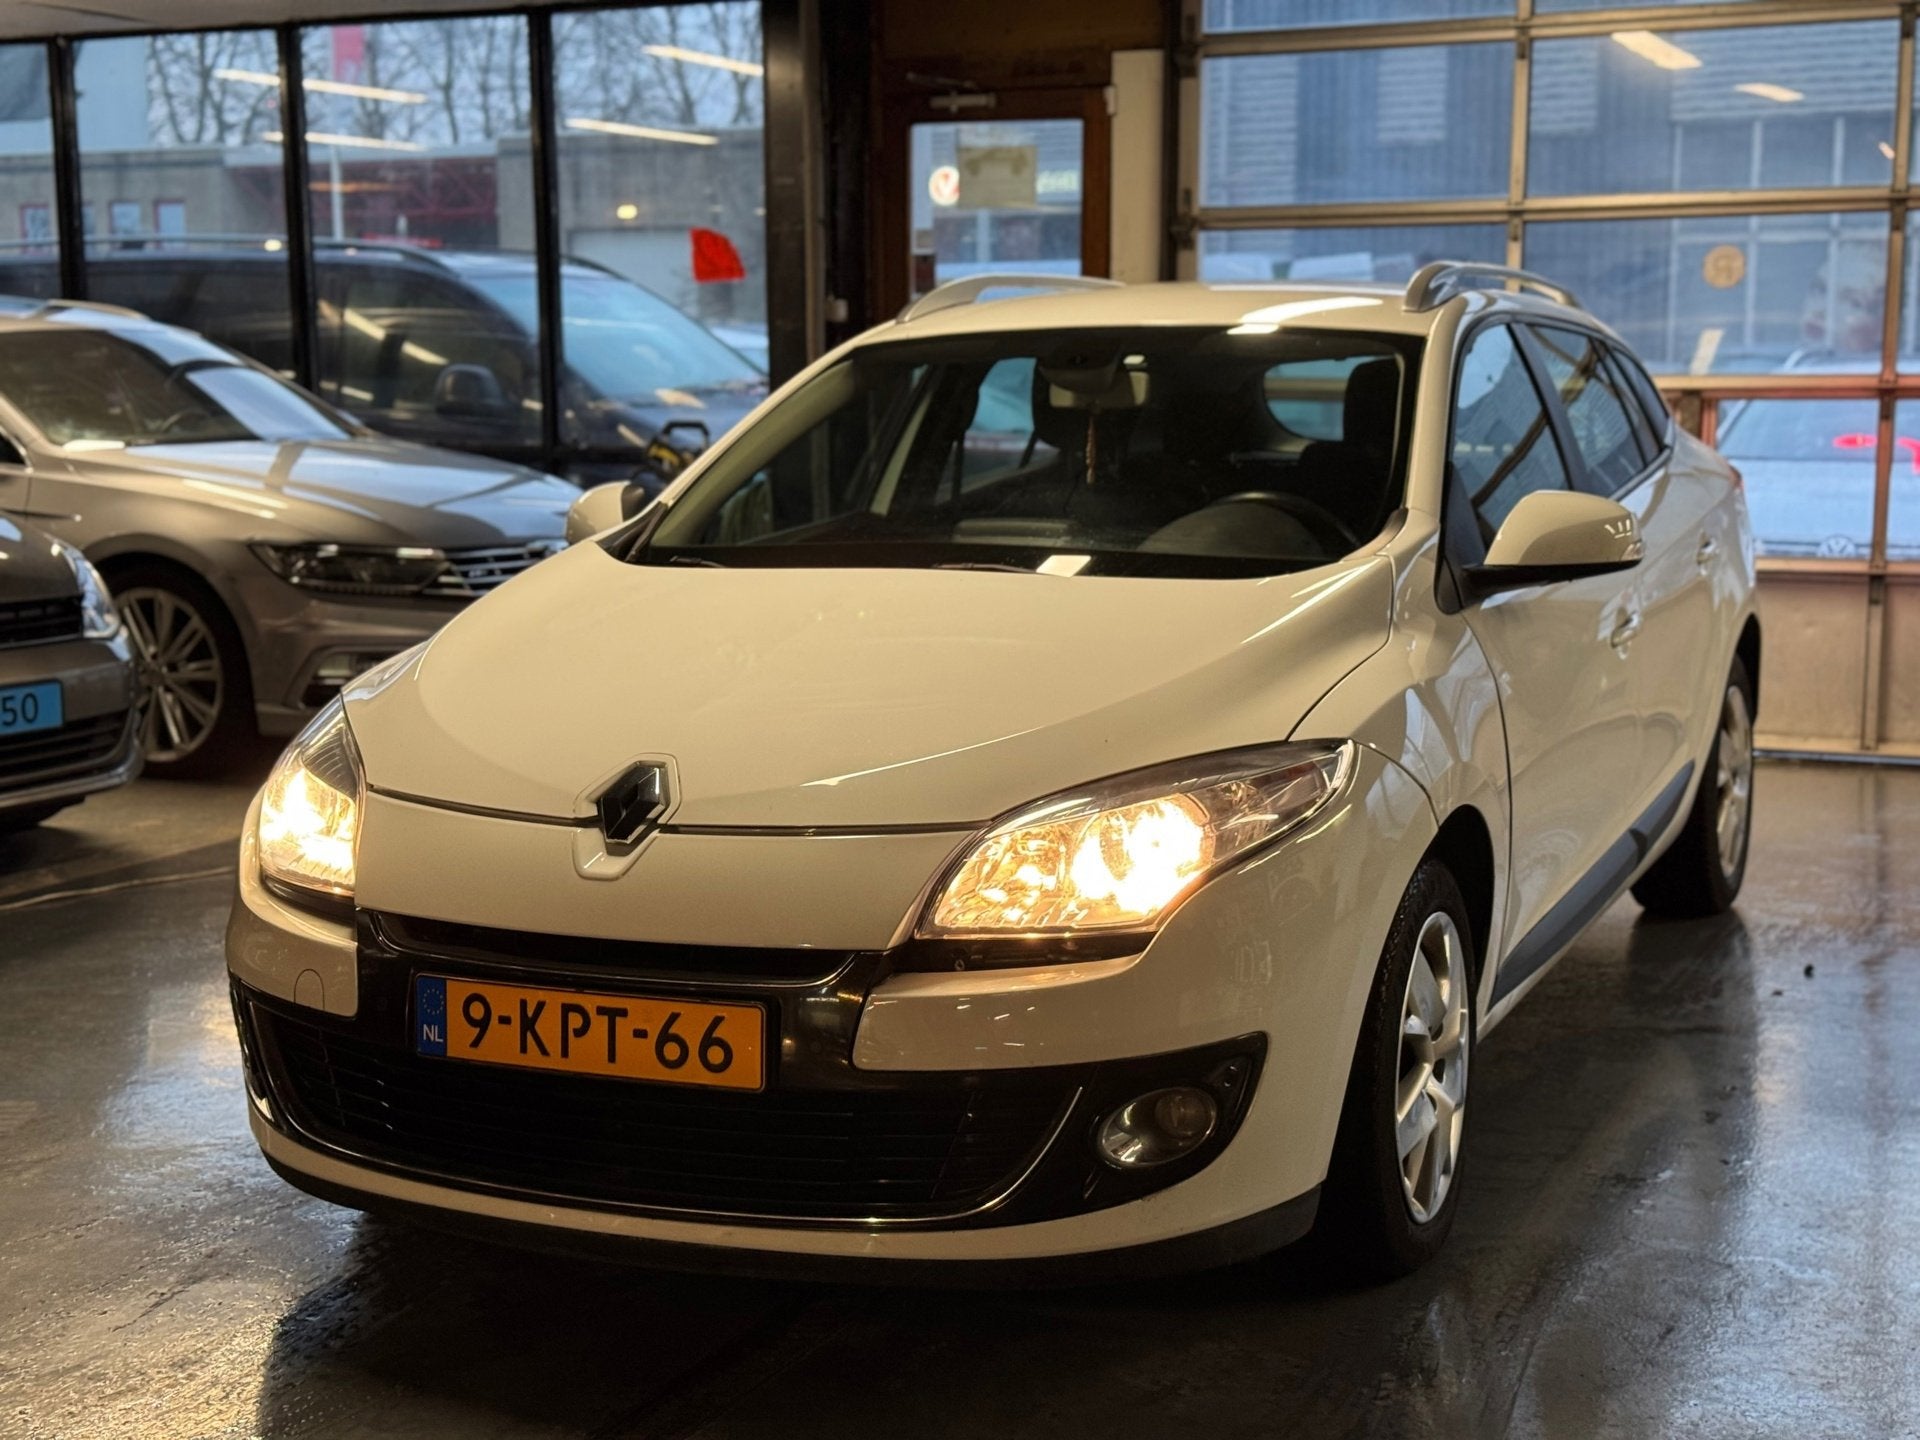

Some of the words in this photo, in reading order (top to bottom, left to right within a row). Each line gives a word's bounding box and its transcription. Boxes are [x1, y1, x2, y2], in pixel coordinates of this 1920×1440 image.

[2, 693, 39, 727] 50
[423, 1023, 444, 1043] NL
[462, 993, 734, 1074] 9-KPT-66
